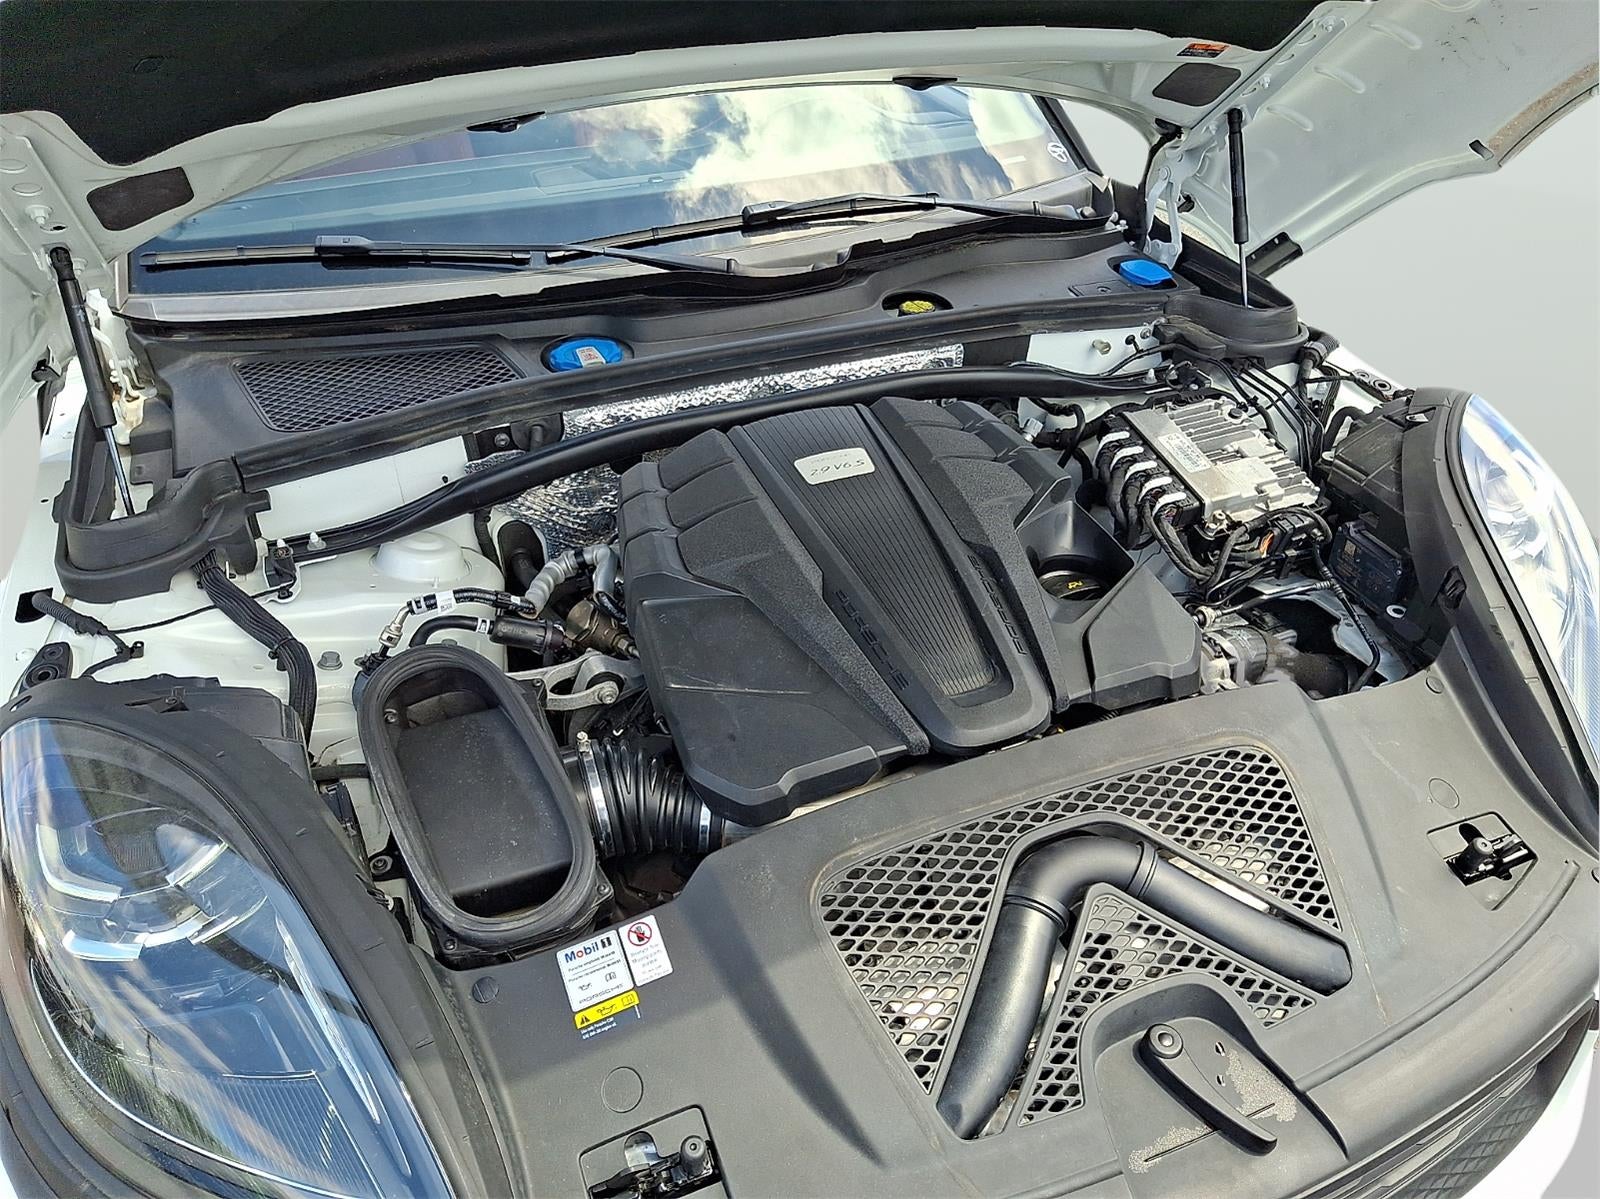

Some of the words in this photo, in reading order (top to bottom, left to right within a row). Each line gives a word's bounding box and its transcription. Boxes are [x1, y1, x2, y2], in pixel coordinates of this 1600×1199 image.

[833, 589, 910, 690] PORSCHE
[967, 554, 1028, 655] PORSCHE
[564, 941, 600, 963] Mobil
